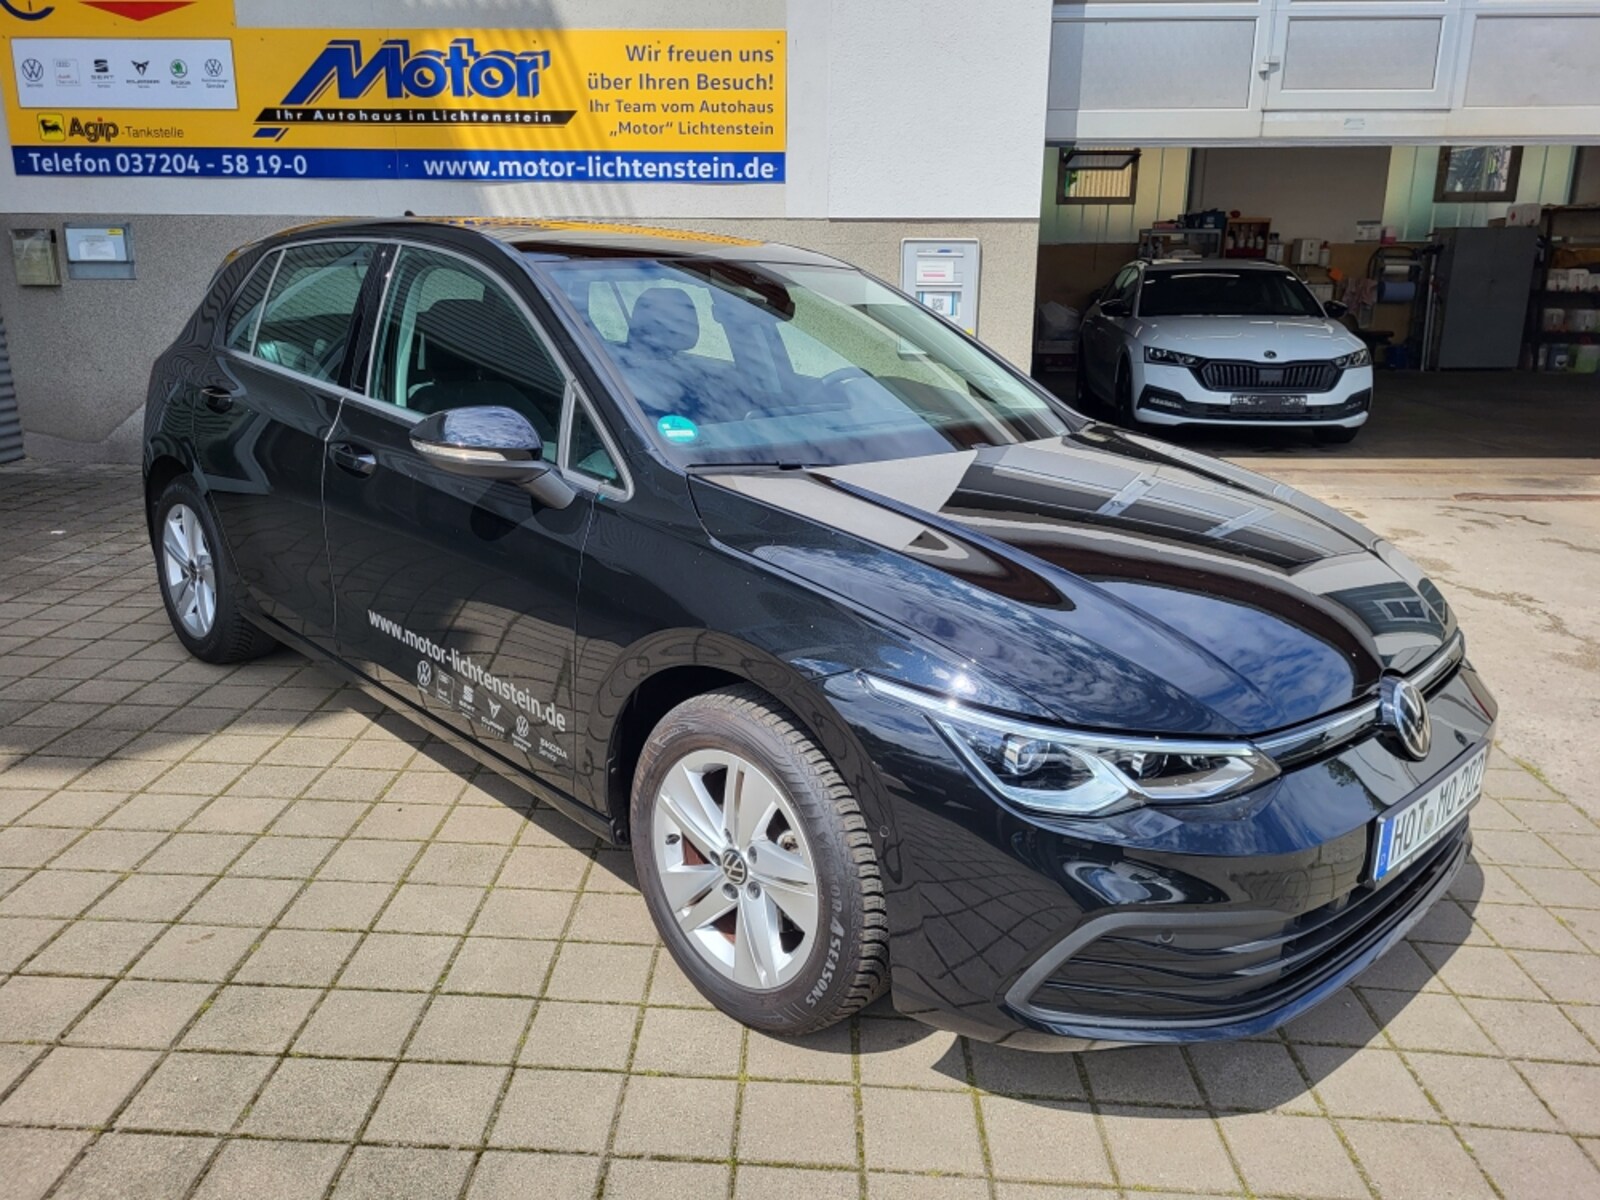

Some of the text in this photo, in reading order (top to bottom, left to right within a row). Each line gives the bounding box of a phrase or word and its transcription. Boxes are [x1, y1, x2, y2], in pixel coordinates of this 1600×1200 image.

[625, 44, 774, 63] Wir freuen uns
[280, 38, 550, 106] Motor
[587, 72, 774, 91] über Ihren Besuch!
[275, 109, 552, 123] Ihr Autohaus in Lichtenstein
[589, 99, 774, 114] Ihr Team vom Autohaus
[68, 116, 119, 143] Agip
[677, 121, 774, 136] Lichtenstein
[28, 152, 112, 173] Telefon
[115, 154, 201, 174] 037204
[221, 154, 250, 175] 58
[255, 155, 308, 175] 19-0
[423, 155, 775, 179] www.motor-lichtenstein.de
[367, 608, 566, 732] www.motor-lichtenstein.de
[1391, 798, 1428, 861] HOT
